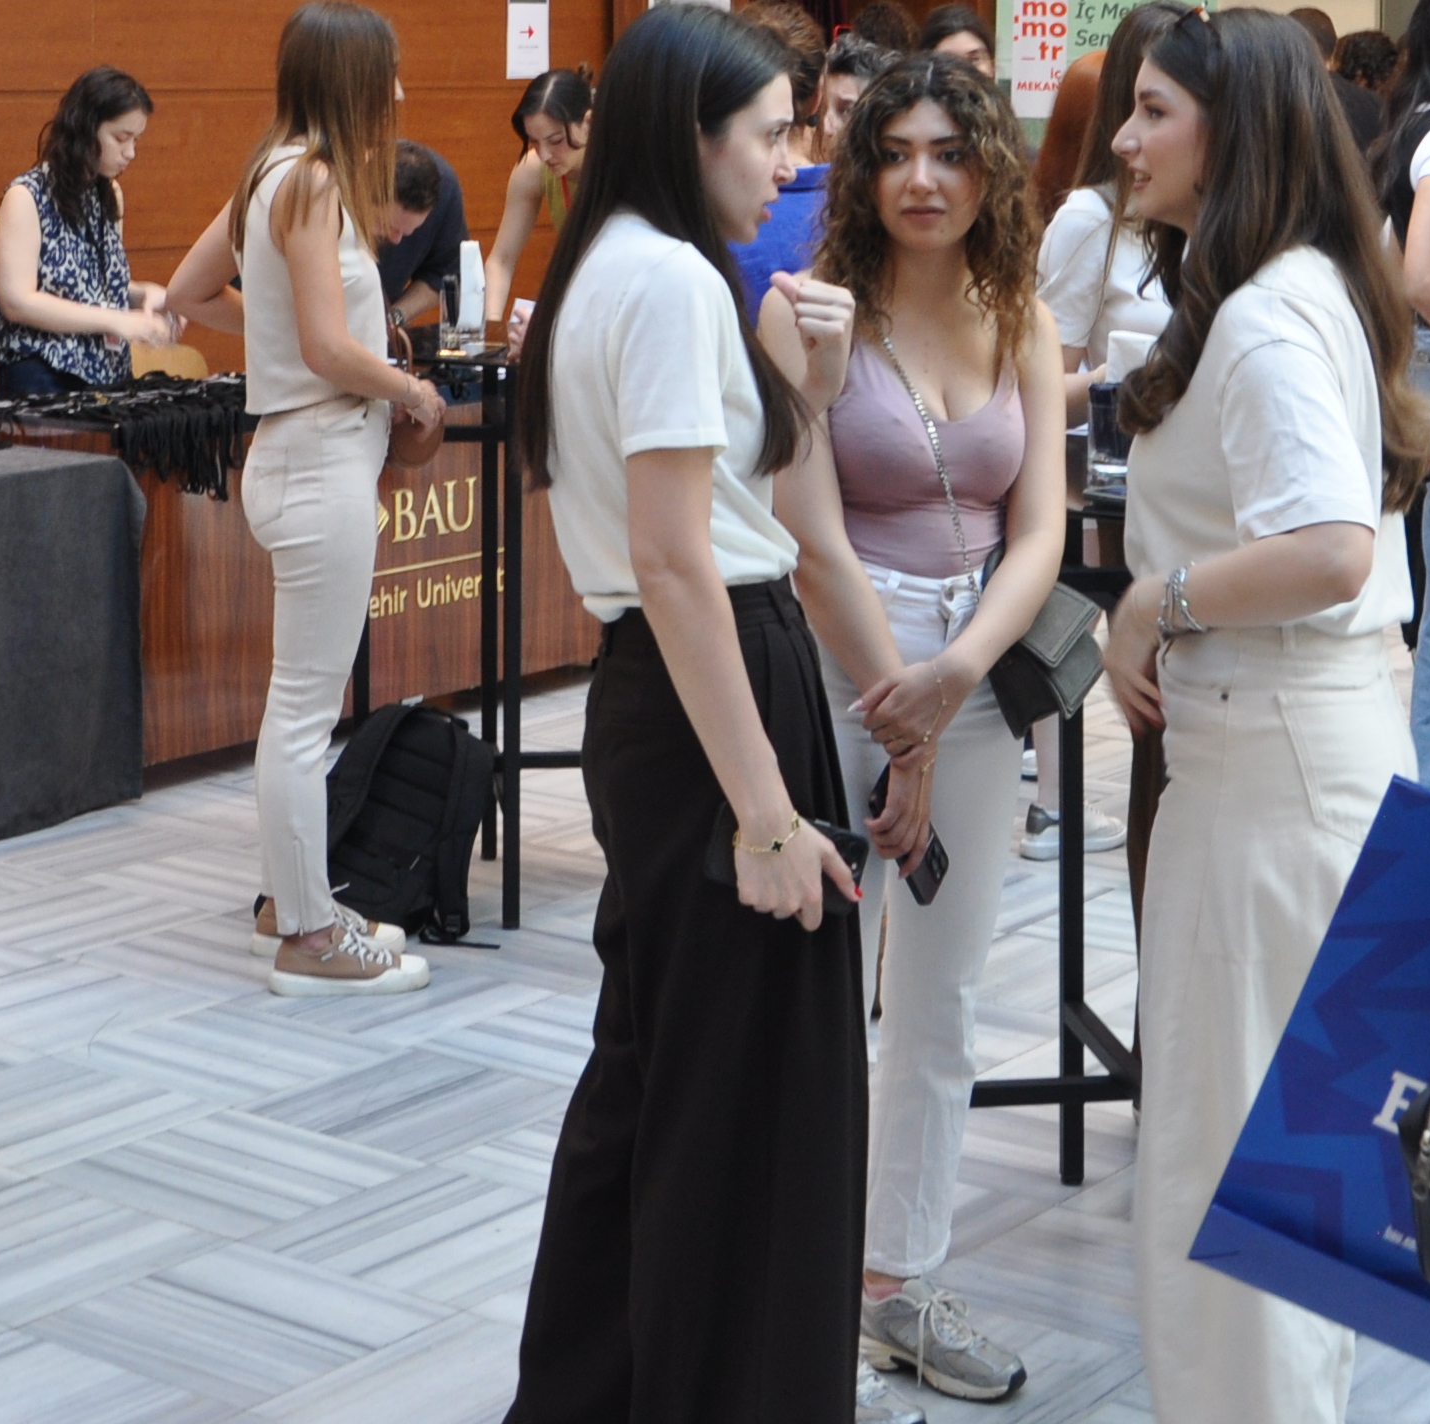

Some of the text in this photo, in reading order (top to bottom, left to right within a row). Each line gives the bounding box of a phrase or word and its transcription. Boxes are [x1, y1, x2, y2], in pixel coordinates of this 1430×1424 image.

[1100, 1, 1138, 20] Me
[390, 476, 477, 543] BAU
[368, 584, 408, 619] ehir
